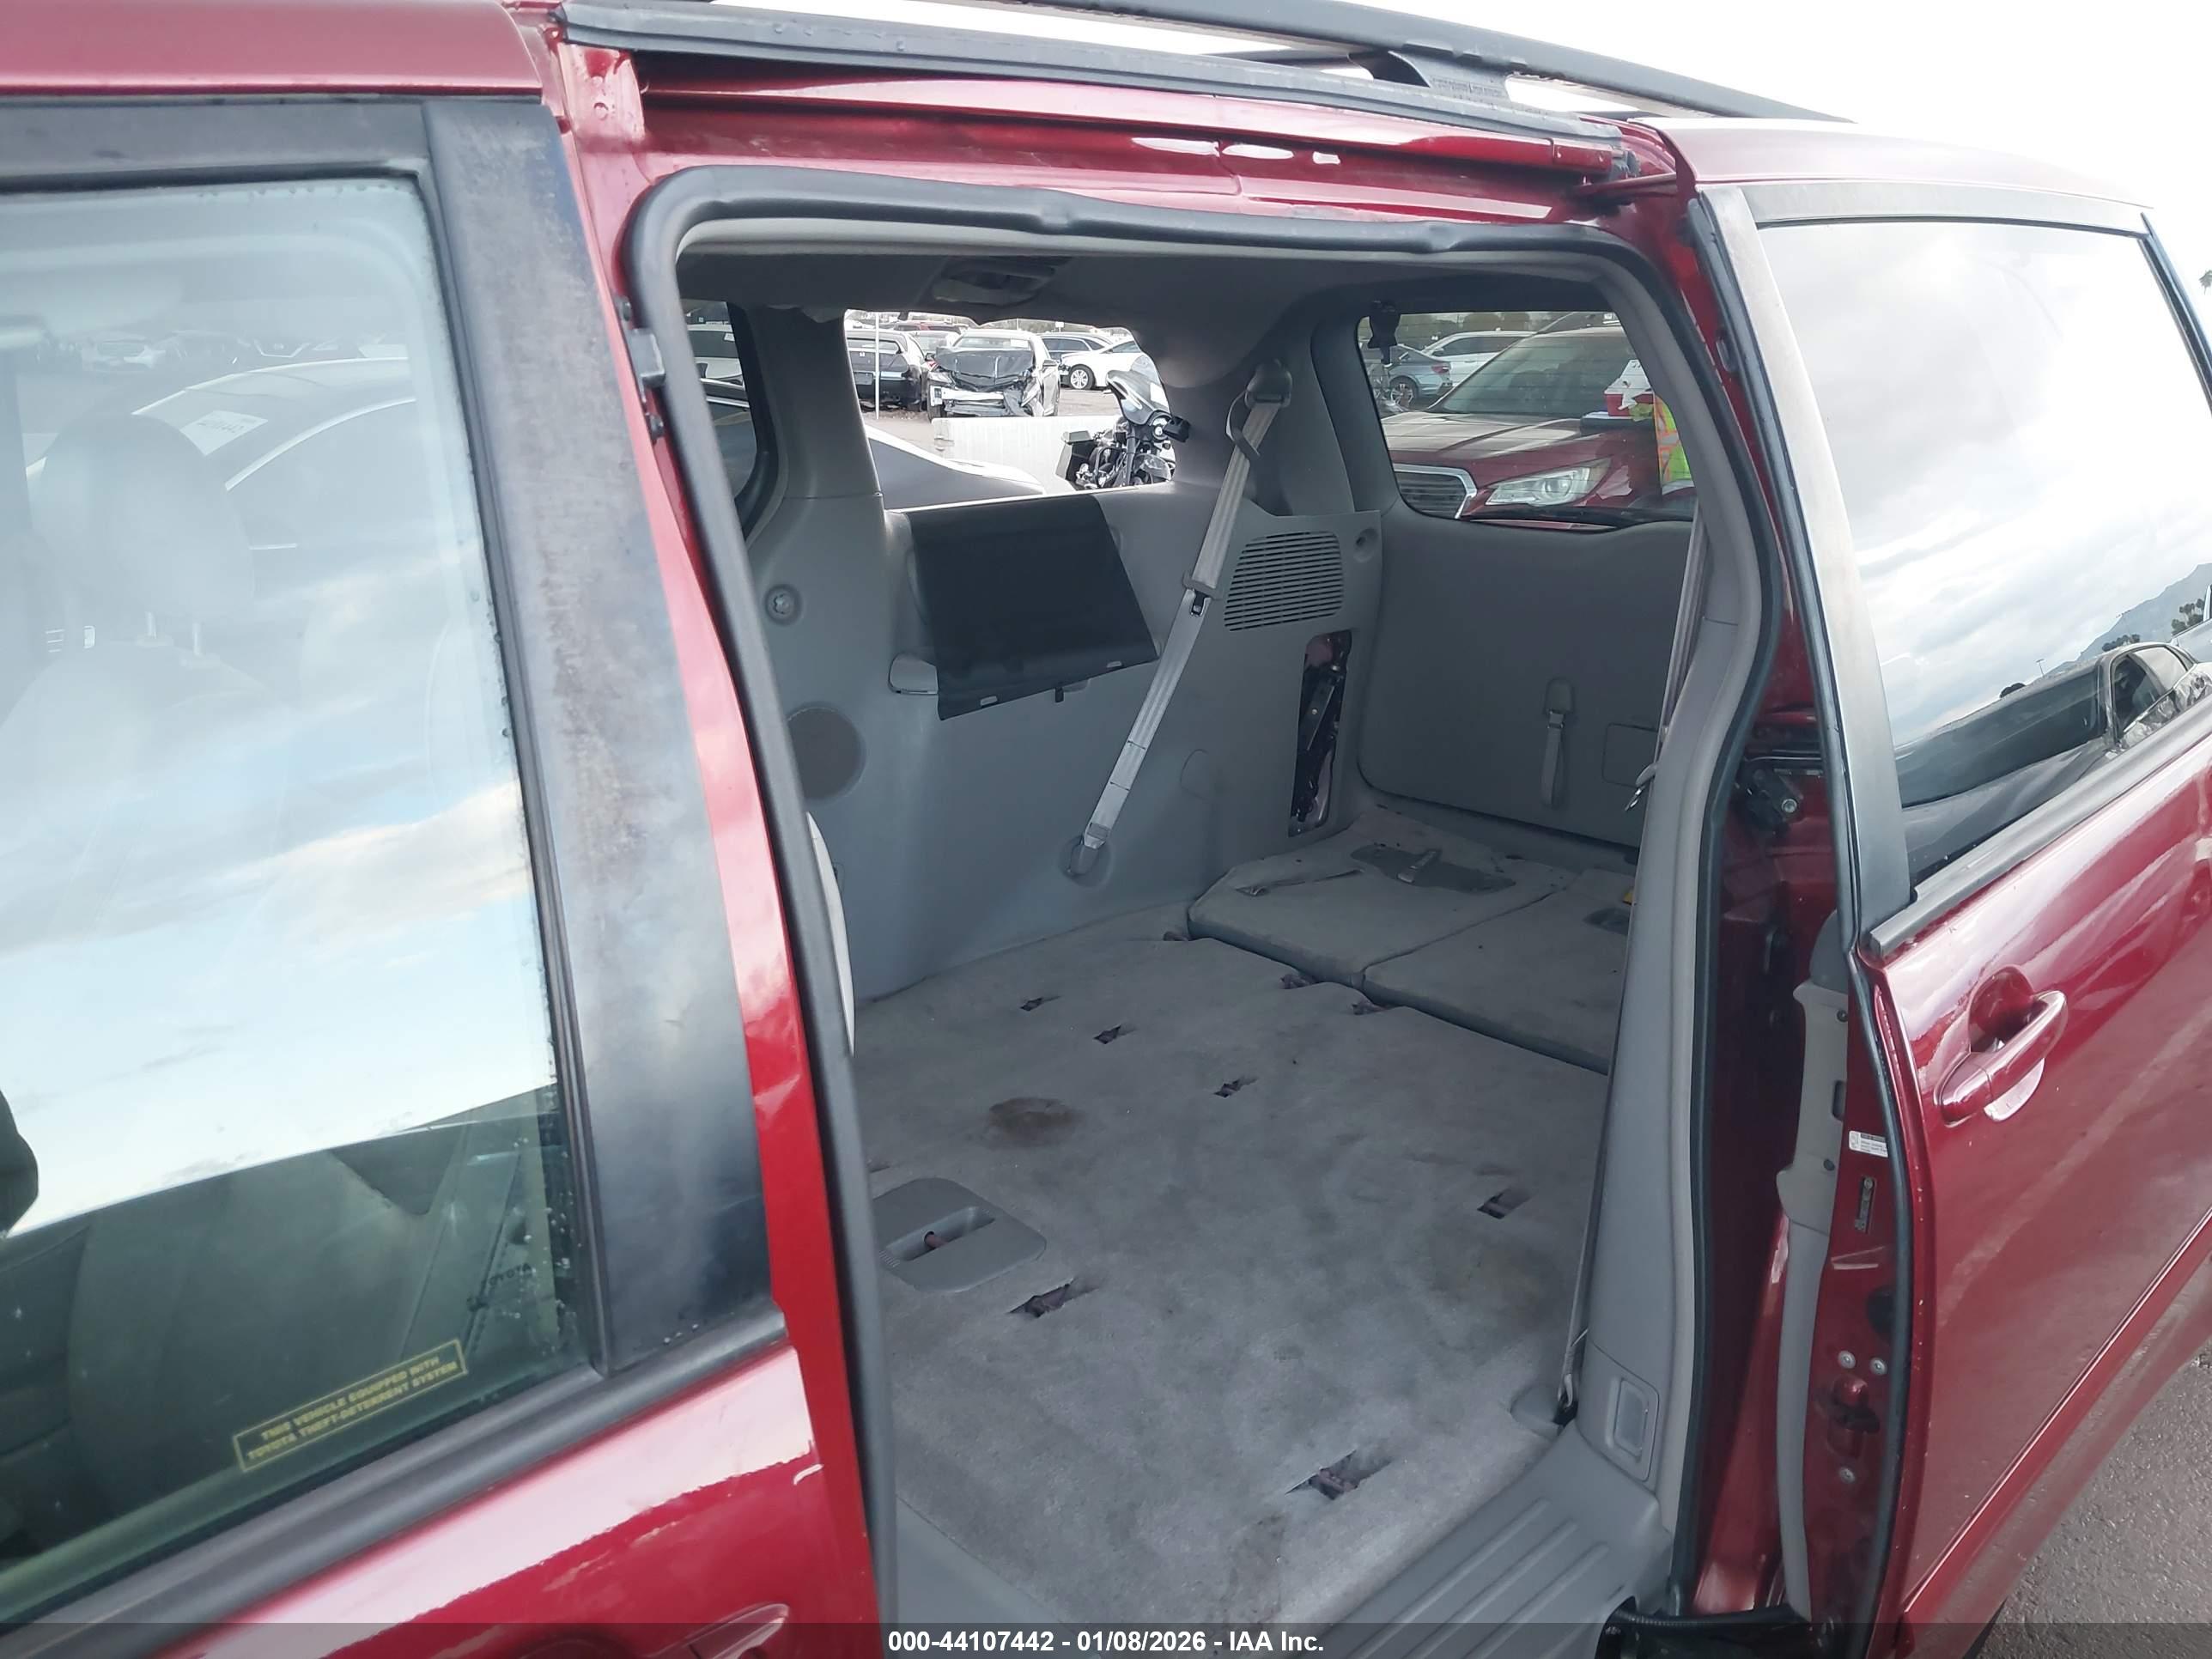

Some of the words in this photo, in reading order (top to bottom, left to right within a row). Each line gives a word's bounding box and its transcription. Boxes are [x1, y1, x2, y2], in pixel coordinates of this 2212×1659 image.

[247, 1433, 297, 1460] TOYOTA
[412, 1361, 458, 1389] SYSTEM
[293, 1397, 346, 1426] VEHICLE
[348, 1370, 408, 1402] EQUIPPED
